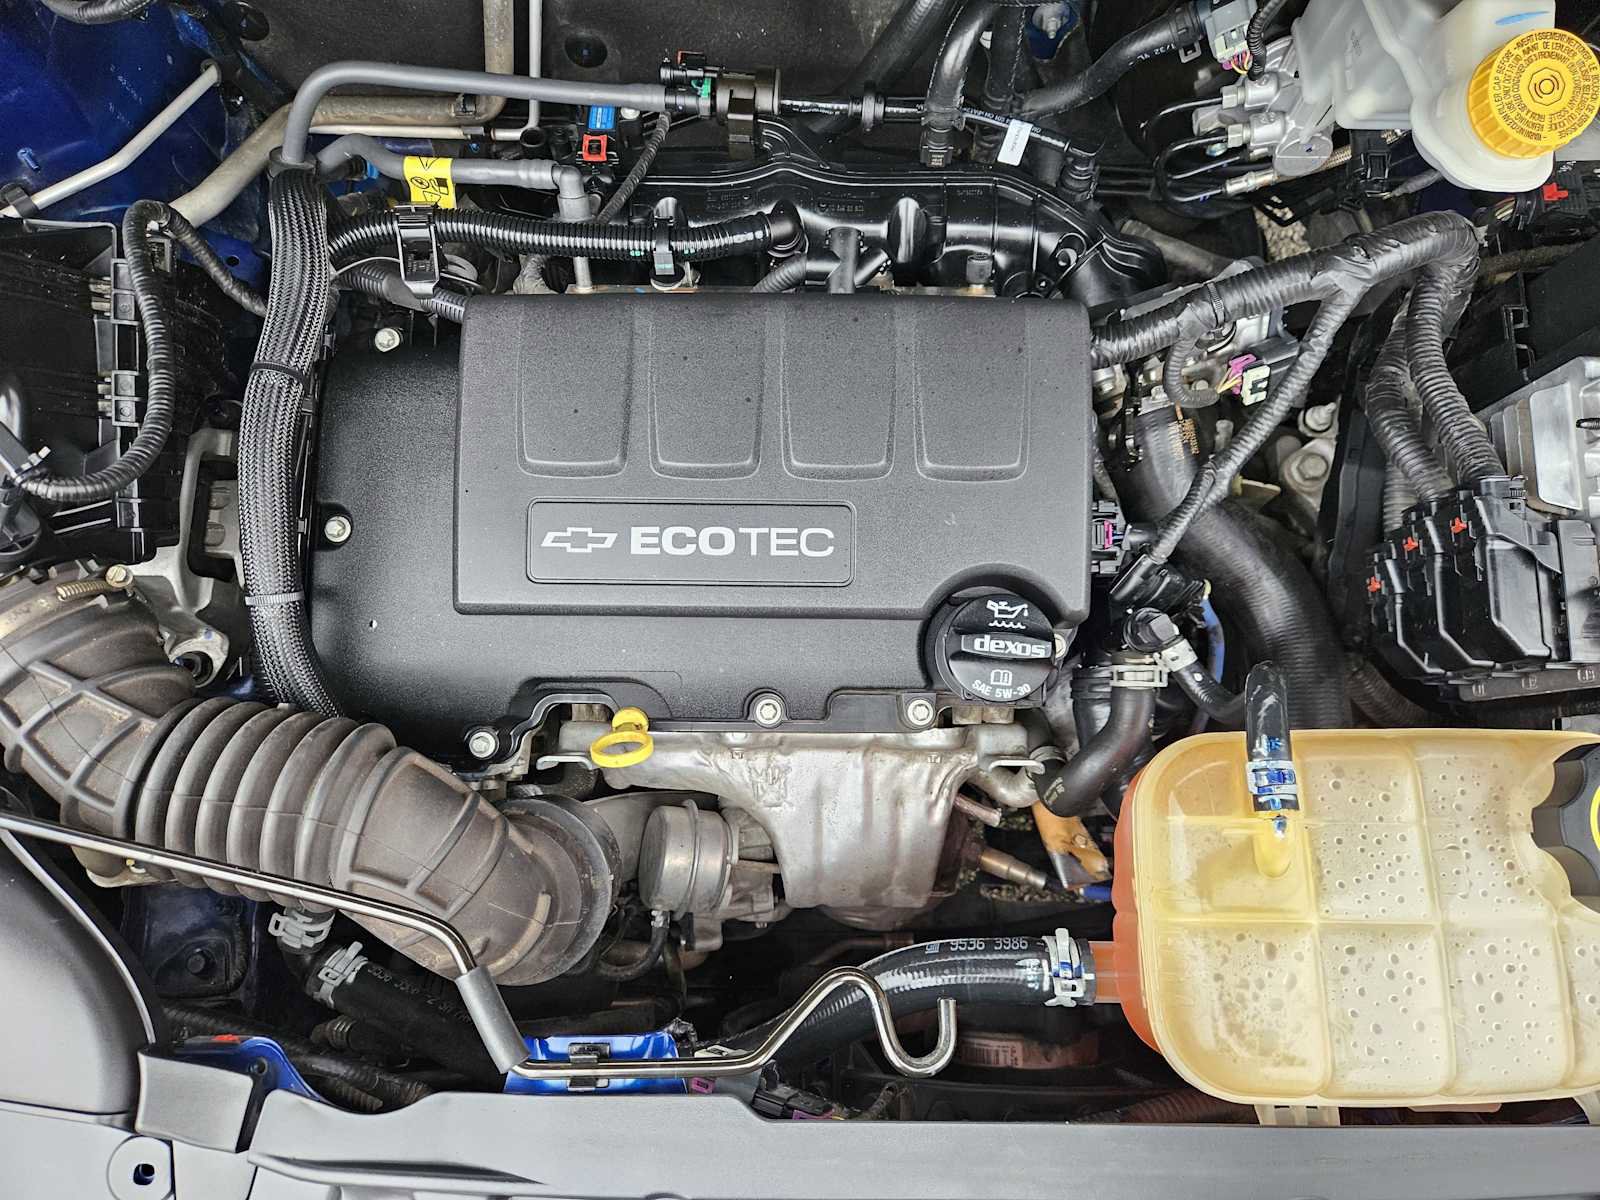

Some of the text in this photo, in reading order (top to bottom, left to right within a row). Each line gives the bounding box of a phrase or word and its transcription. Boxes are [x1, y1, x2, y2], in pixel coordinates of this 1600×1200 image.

[1521, 42, 1539, 56] AVANT
[1542, 41, 1550, 49] DE
[1495, 48, 1514, 74] BEFORE
[1587, 61, 1598, 71] LE
[1492, 75, 1501, 90] CAP
[1502, 85, 1511, 100] ONLY
[1493, 92, 1507, 115] FILLER
[1504, 99, 1517, 114] USE
[1585, 103, 1595, 114] DE
[630, 526, 834, 557] ECOTEC
[974, 634, 1046, 657] dexos
[972, 679, 1031, 698] SAE 5W-30
[950, 938, 985, 952] 9536
[994, 937, 1028, 951] 3986
